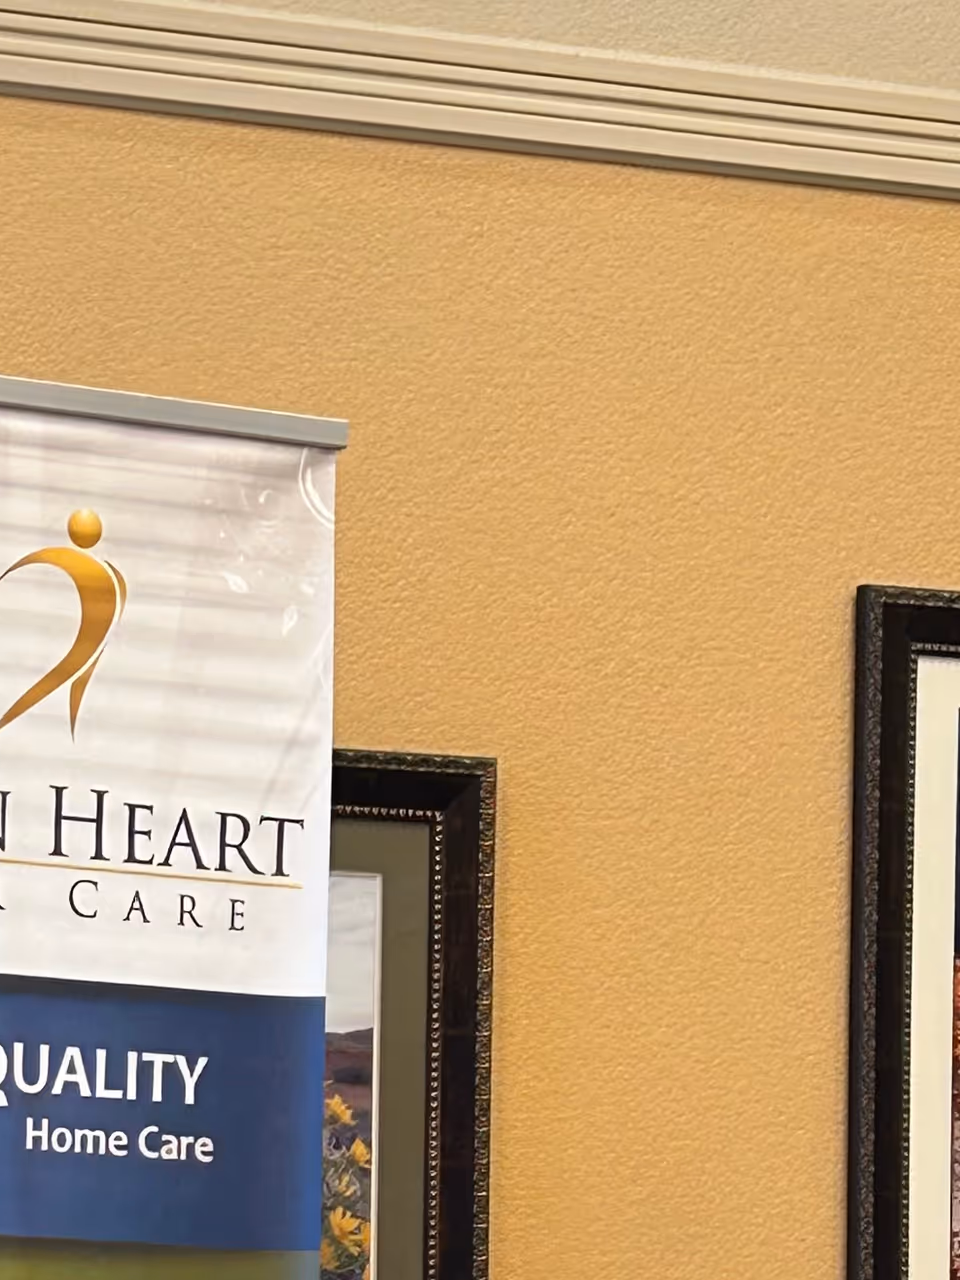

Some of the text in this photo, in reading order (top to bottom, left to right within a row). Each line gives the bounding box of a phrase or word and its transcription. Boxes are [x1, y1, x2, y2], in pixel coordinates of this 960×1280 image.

[48, 783, 305, 878] HEART
[68, 879, 246, 932] CARE
[25, 1116, 214, 1163] Home Care
